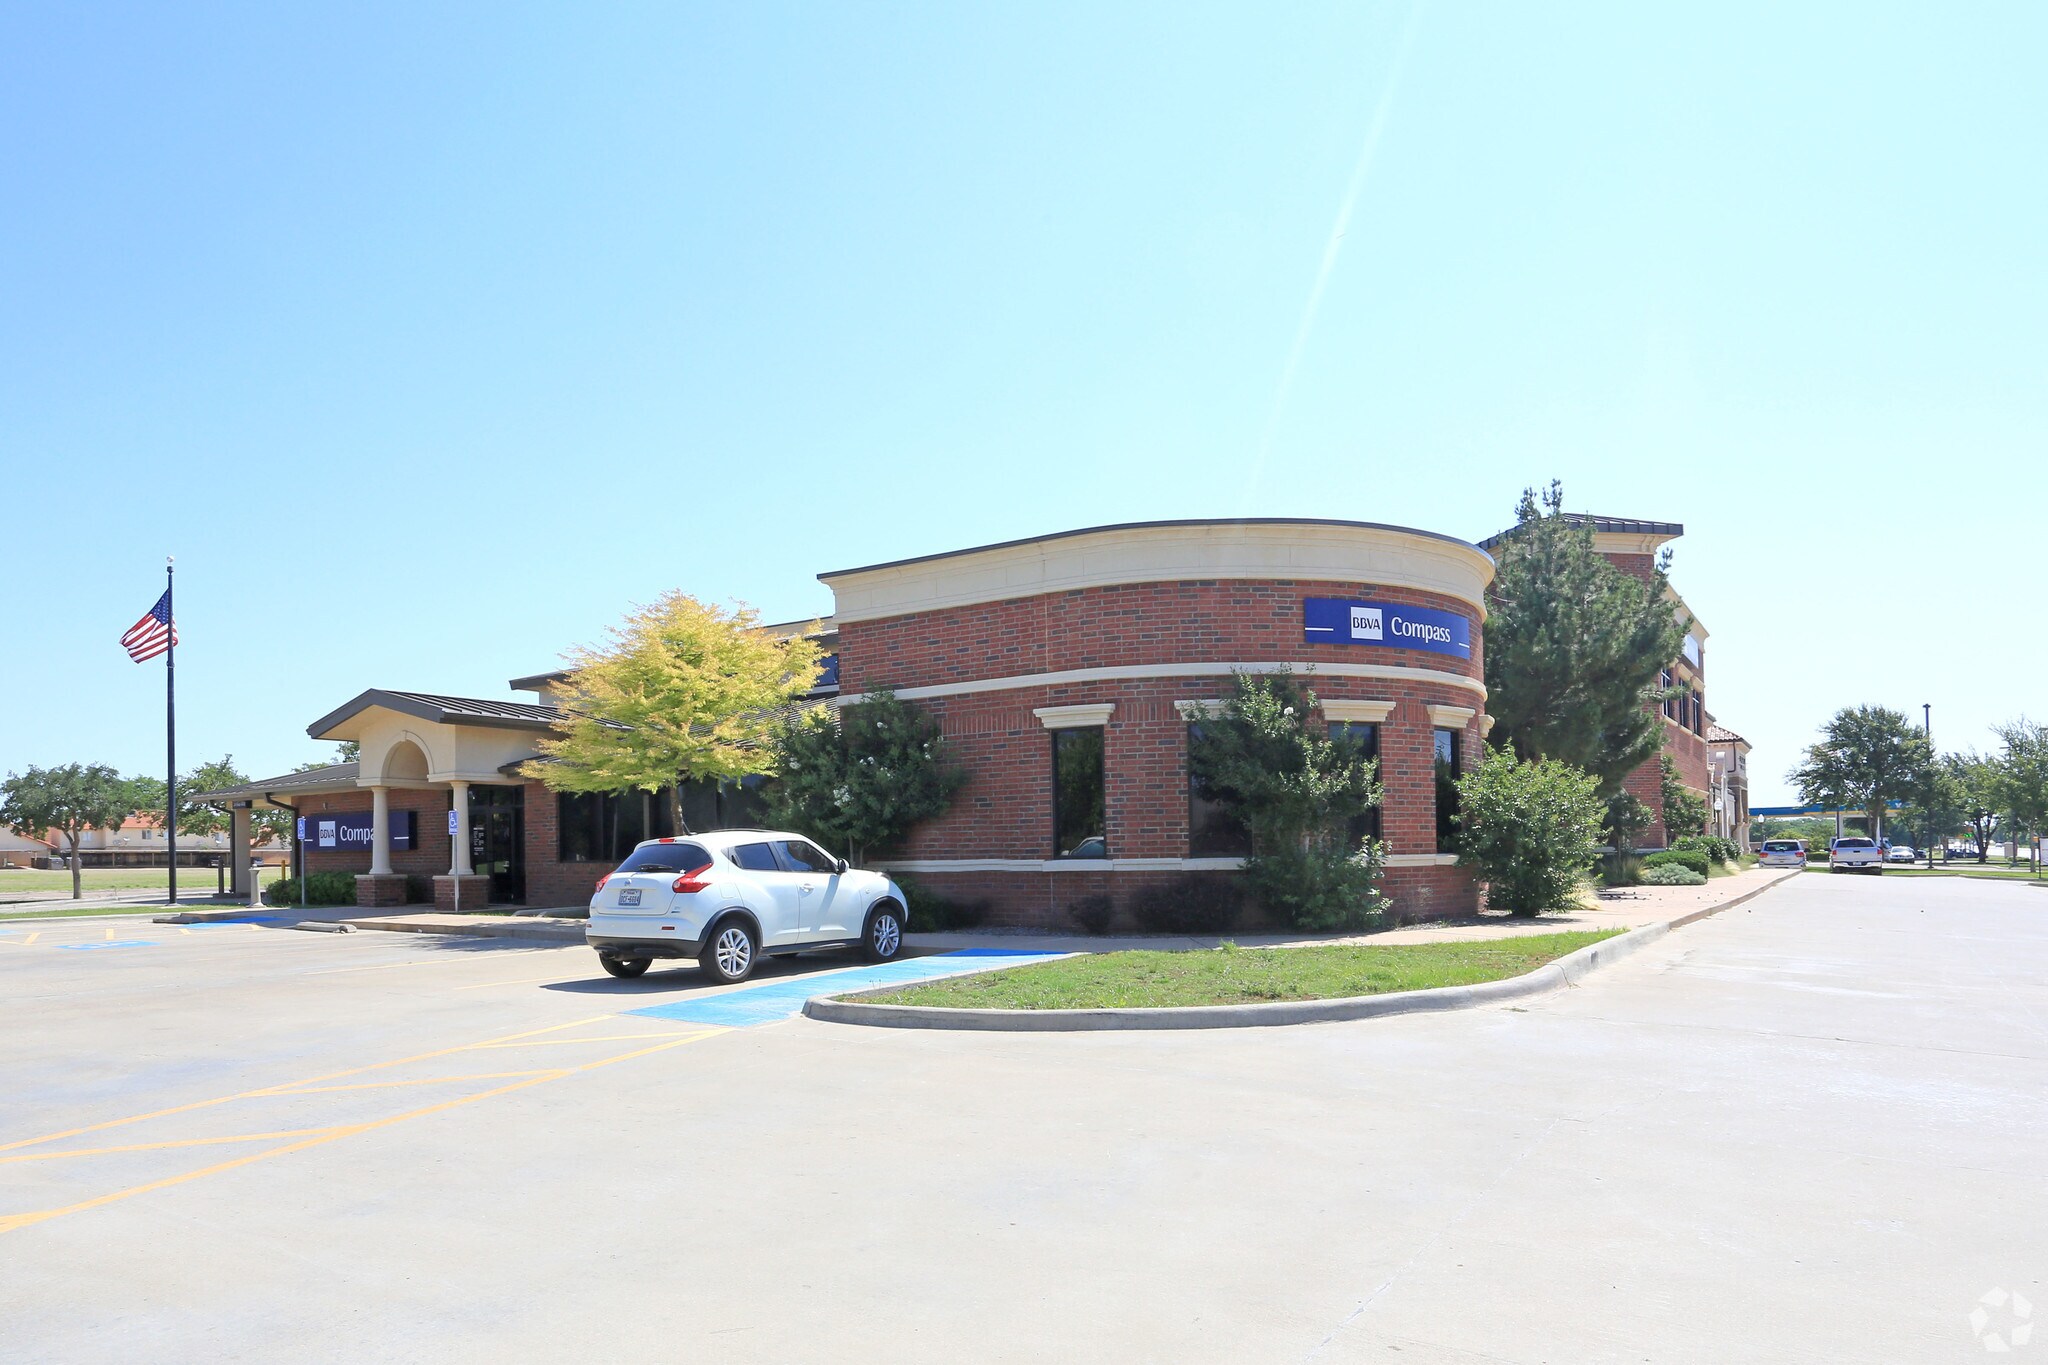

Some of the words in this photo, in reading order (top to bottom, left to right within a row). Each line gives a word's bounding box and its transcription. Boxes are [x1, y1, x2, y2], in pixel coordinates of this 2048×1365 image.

[1352, 616, 1381, 630] BBVA
[1391, 616, 1451, 643] Compass
[340, 826, 375, 845] Compa
